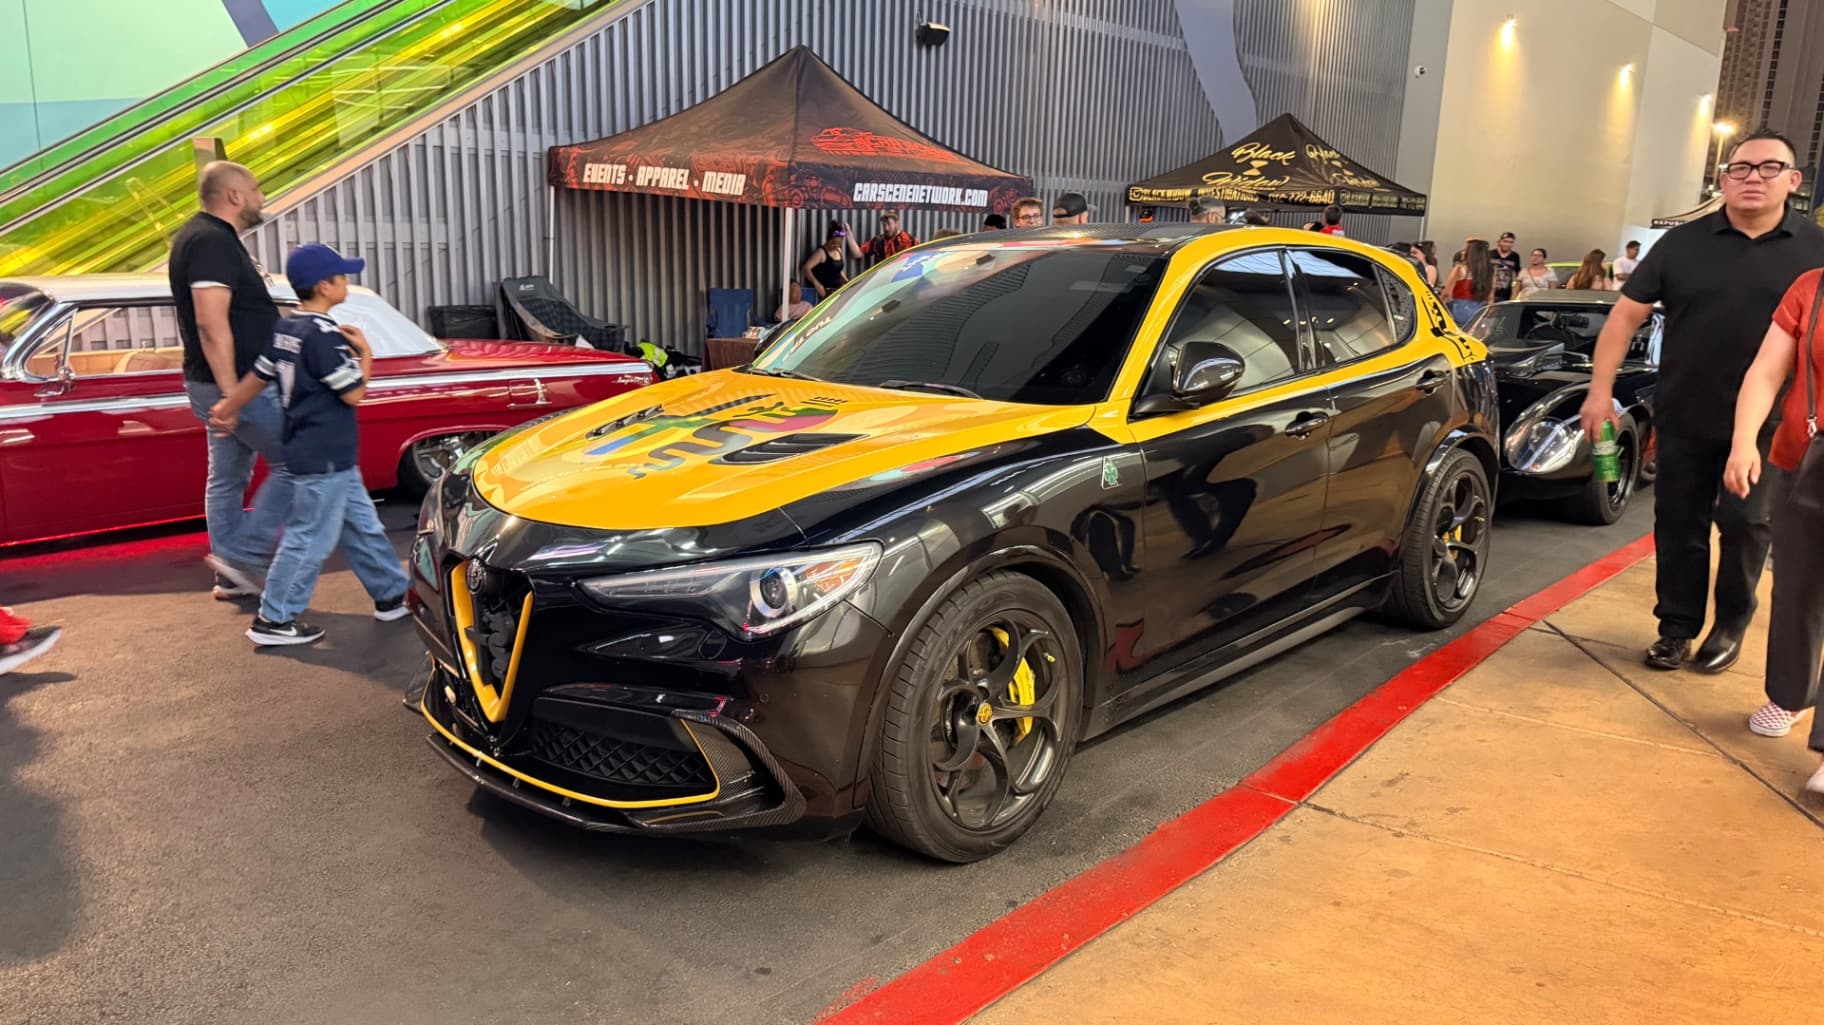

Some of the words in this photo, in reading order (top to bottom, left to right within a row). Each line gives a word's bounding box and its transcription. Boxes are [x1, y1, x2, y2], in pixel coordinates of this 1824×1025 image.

[1231, 142, 1296, 166] Black
[582, 163, 627, 185] EVENTS
[636, 165, 690, 190] APPAREL
[701, 171, 747, 196] MEDIA
[1202, 171, 1291, 187] Widow
[853, 182, 988, 207] CARSCENENETWORK.COM
